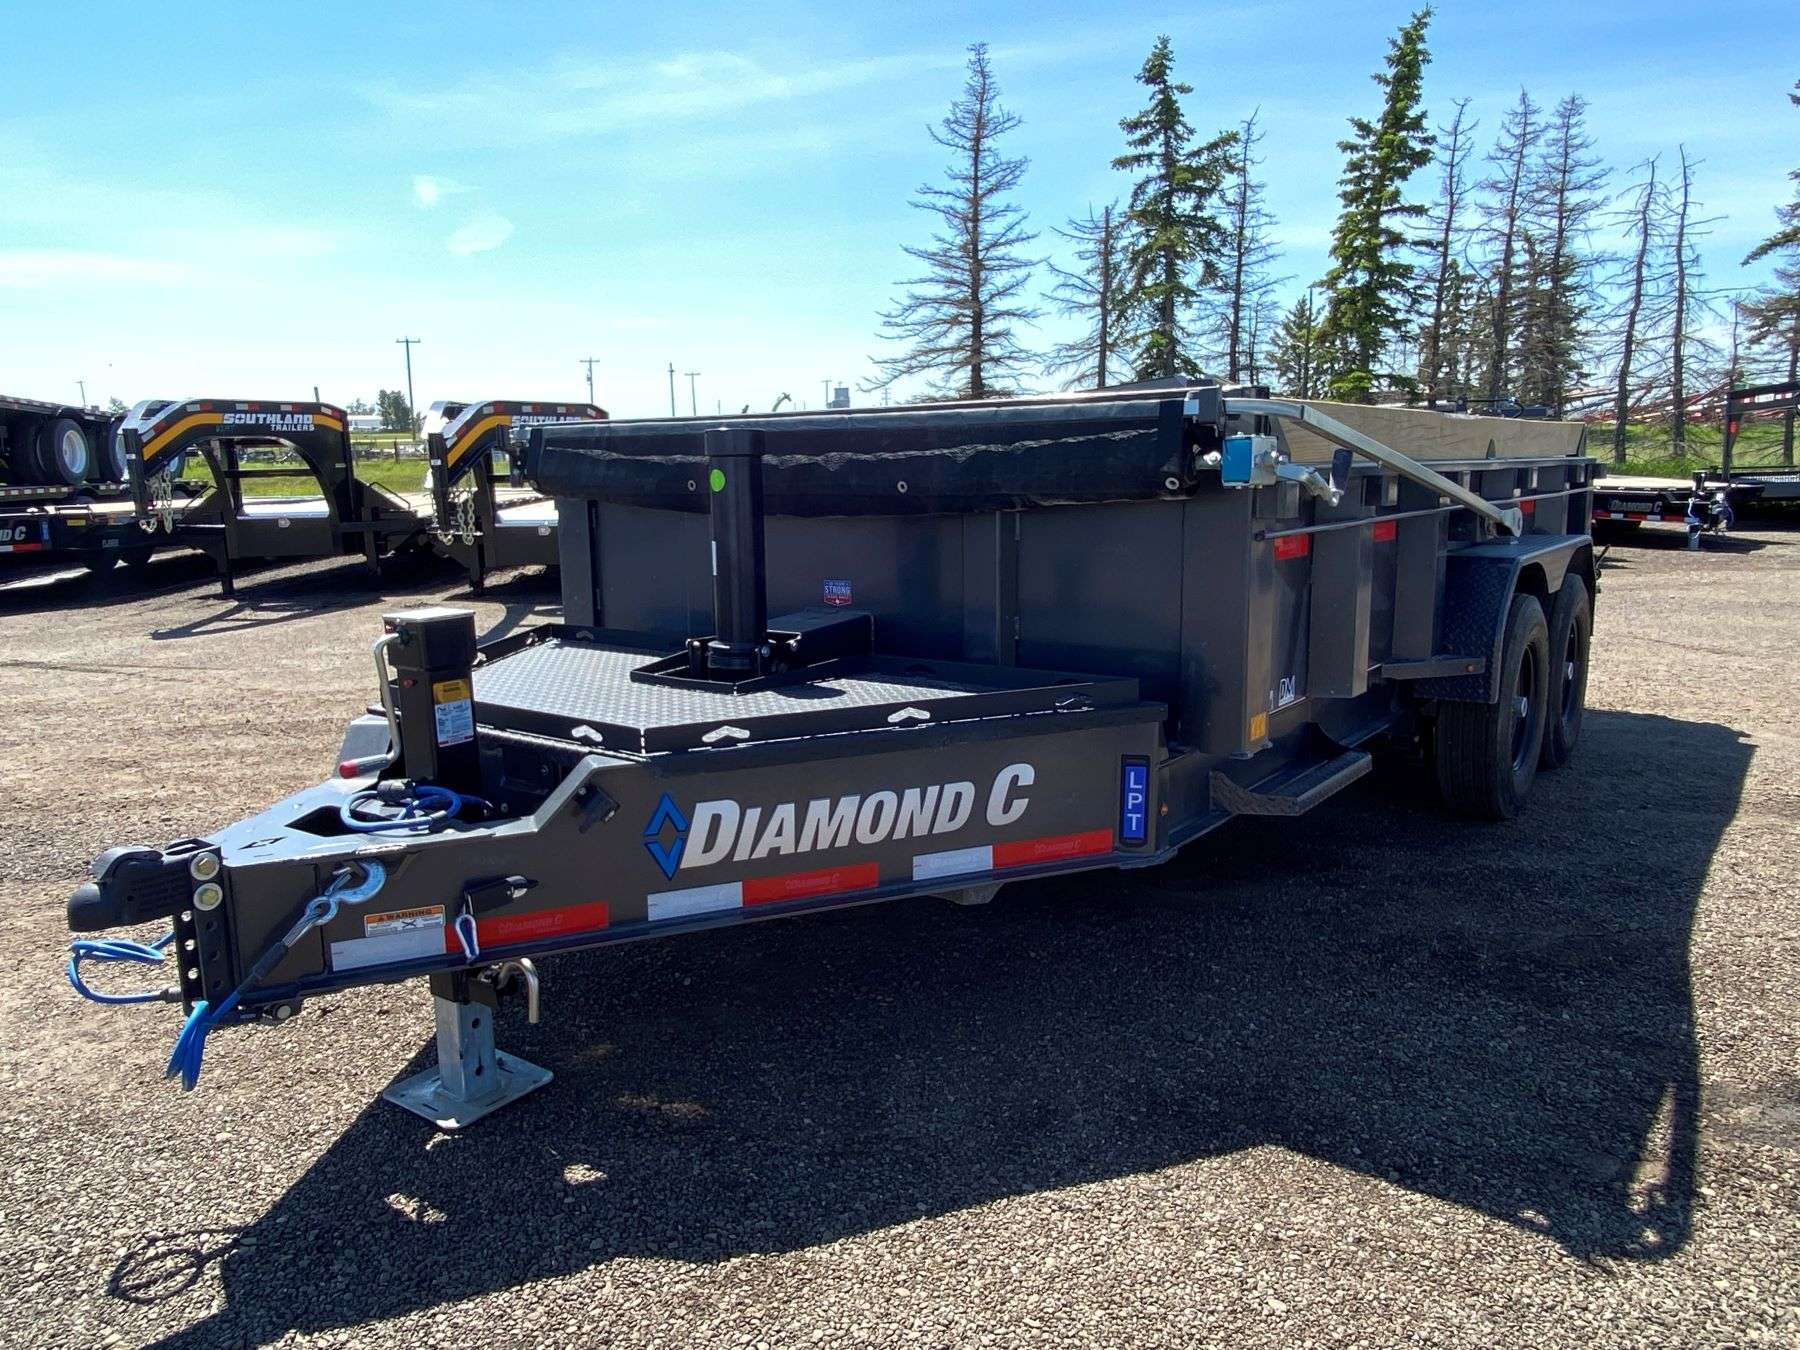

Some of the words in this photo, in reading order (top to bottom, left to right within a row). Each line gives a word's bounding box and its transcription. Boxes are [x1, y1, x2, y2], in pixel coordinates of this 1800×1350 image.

[223, 413, 313, 424] SOUTHLAND
[14, 526, 26, 540] C
[1127, 771, 1143, 831] LPT
[679, 780, 976, 869] DIAMOND
[986, 763, 1035, 826] C
[385, 907, 433, 920] WARNING
